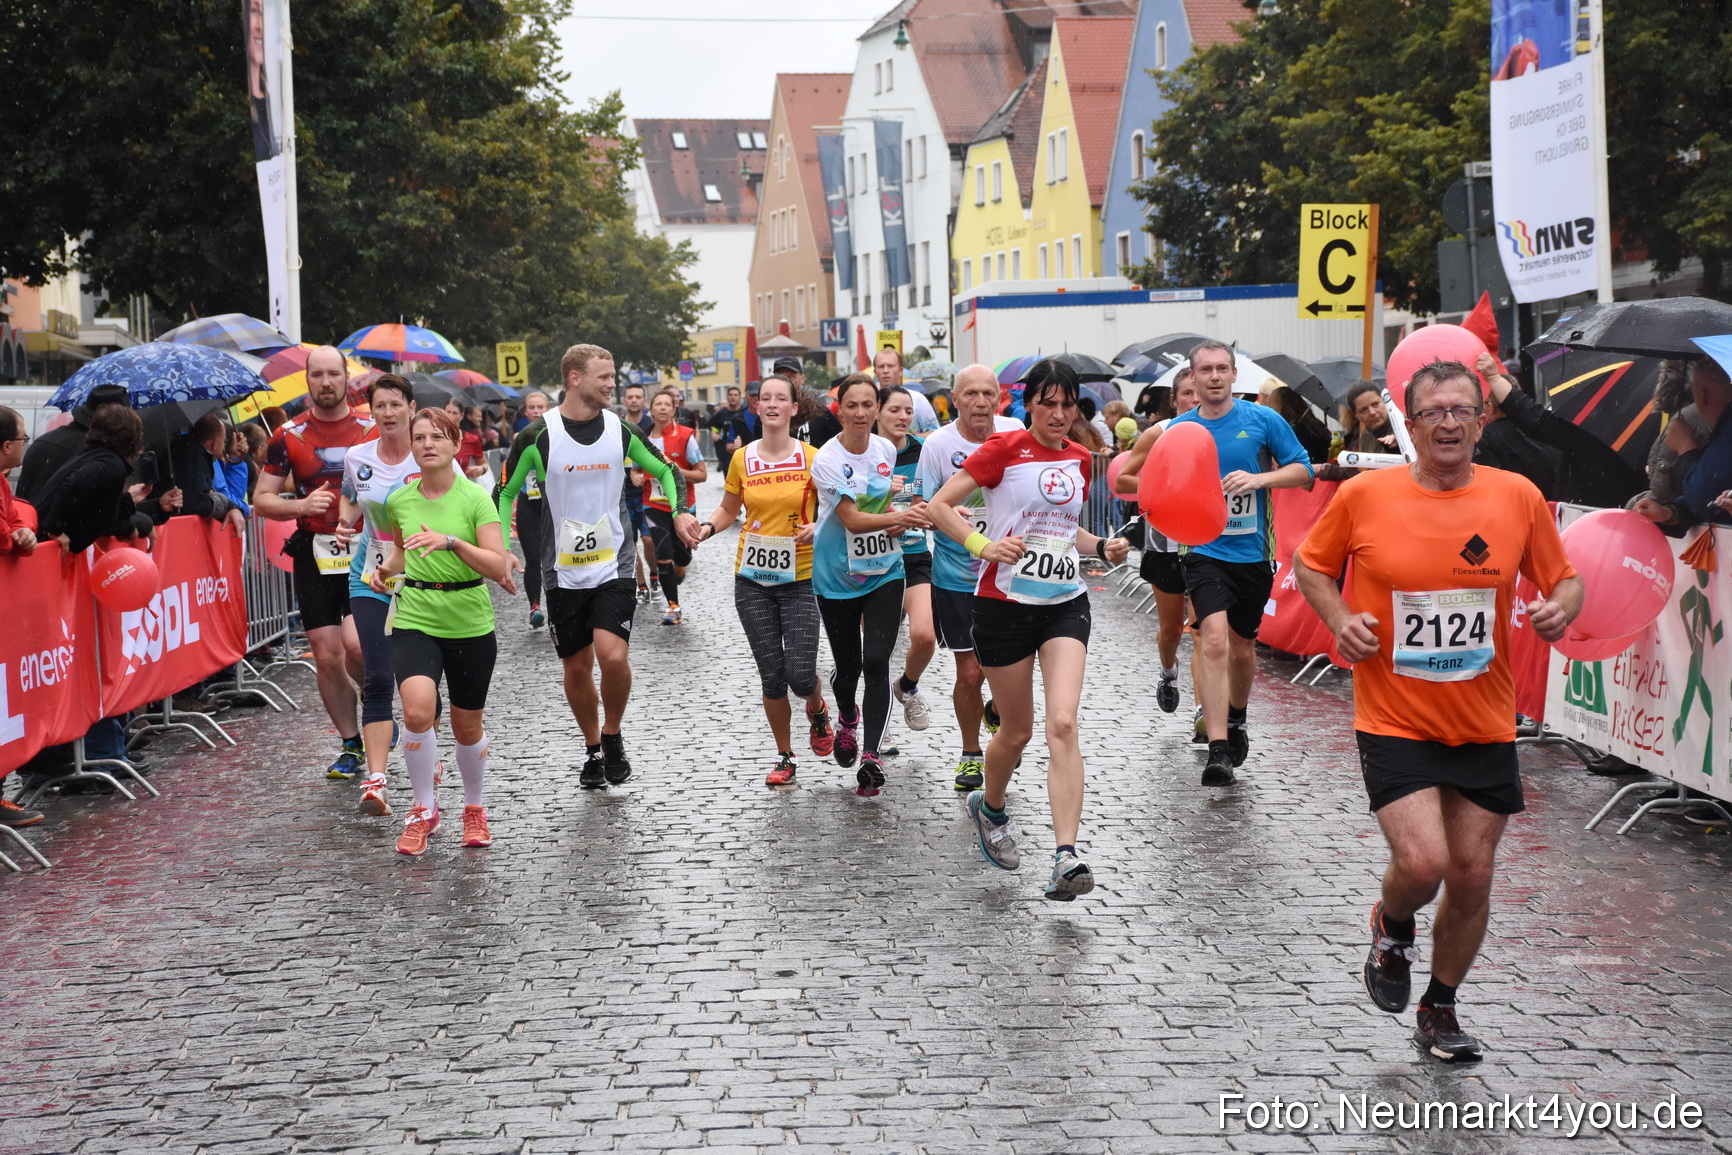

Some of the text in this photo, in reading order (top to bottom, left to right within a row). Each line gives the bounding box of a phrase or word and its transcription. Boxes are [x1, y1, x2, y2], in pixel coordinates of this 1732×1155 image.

[1310, 209, 1369, 229] Block
[1318, 239, 1357, 295] C
[879, 332, 900, 342] Block
[499, 344, 523, 353] Block
[505, 356, 520, 377] D
[576, 463, 612, 471] KLEBL
[746, 476, 772, 488] MAX
[776, 472, 807, 483] BÖGL
[1225, 519, 1242, 529] efan
[574, 531, 597, 552] 25
[853, 533, 894, 556] 3061
[333, 559, 351, 568] Felix
[572, 553, 600, 565] Markus
[746, 546, 791, 569] 2683
[1020, 550, 1075, 580] 2048
[100, 563, 134, 589] RÖDL
[753, 571, 779, 582] Sandra
[1452, 567, 1501, 576] FliesenEichl
[1437, 592, 1486, 605] BOCK
[1405, 611, 1486, 648] 2124
[1428, 656, 1464, 670] Franz
